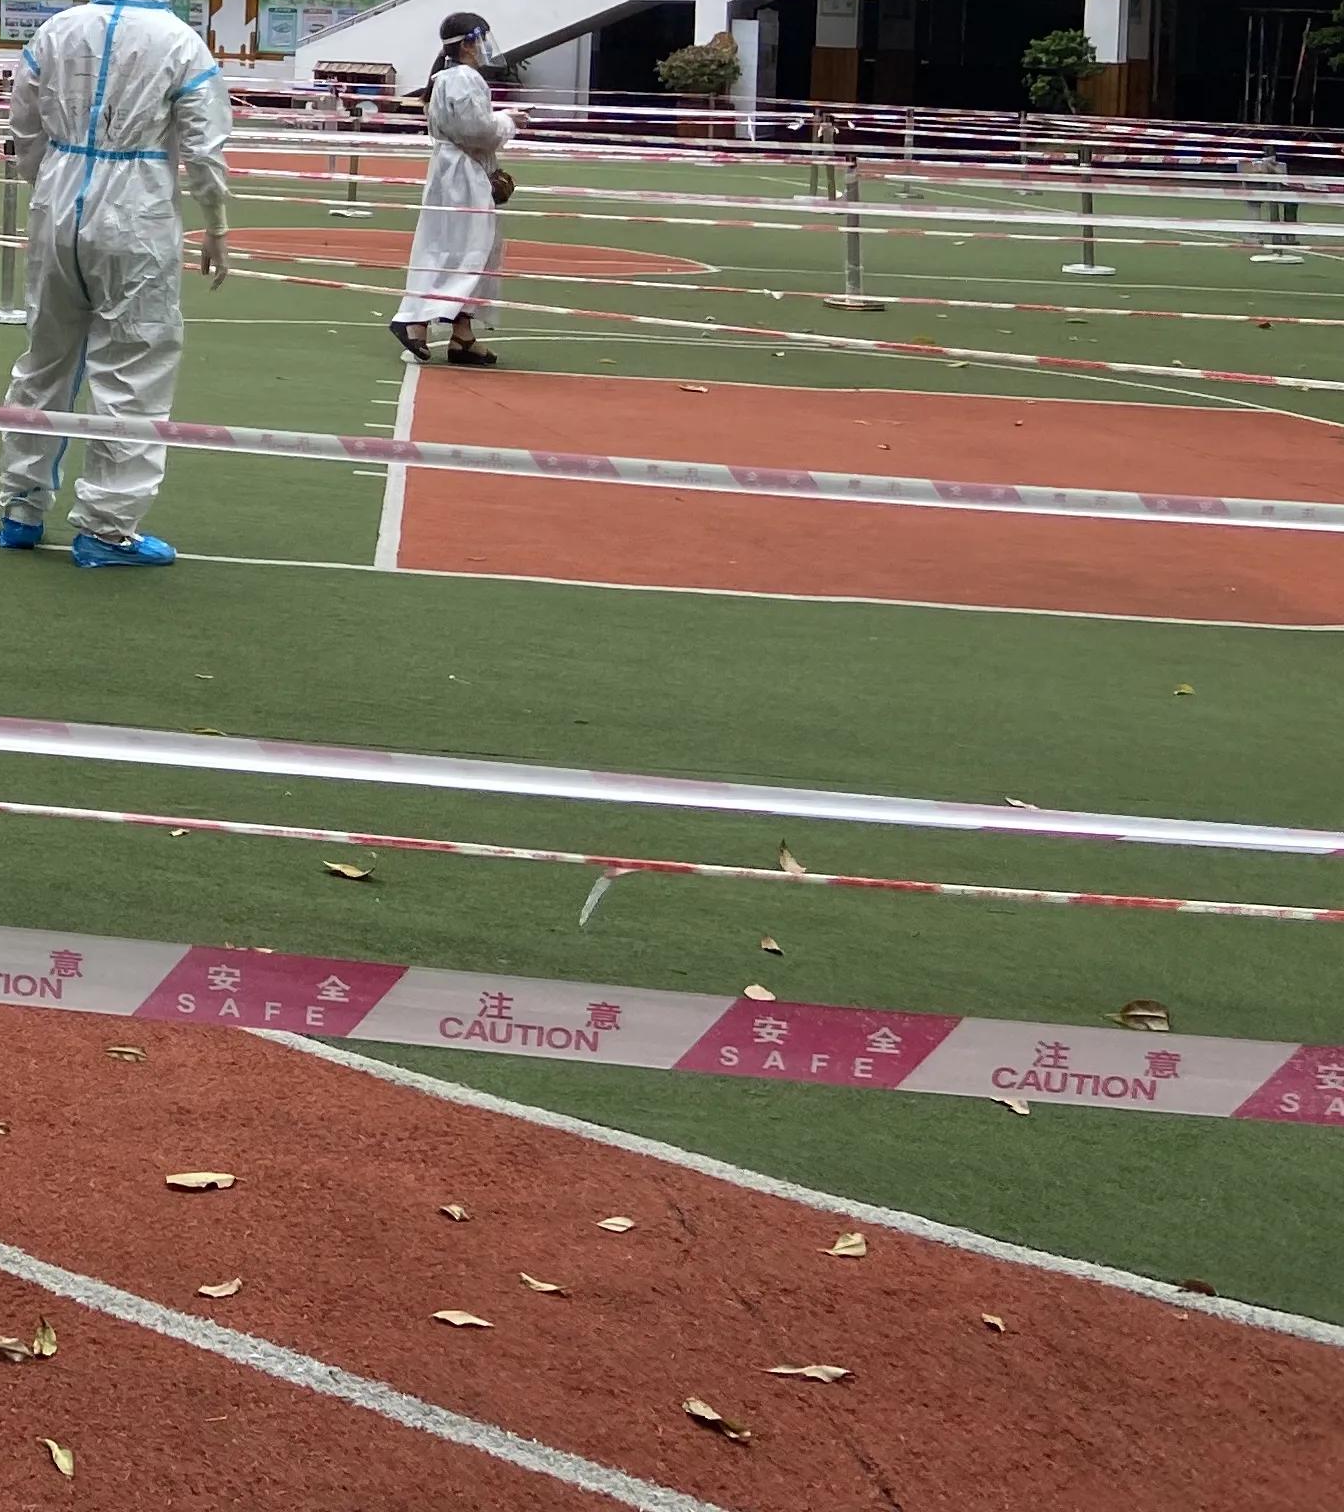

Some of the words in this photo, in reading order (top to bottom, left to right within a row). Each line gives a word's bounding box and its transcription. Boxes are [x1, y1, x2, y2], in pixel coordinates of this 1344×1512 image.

[208, 964, 350, 1003] 安全
[177, 993, 324, 1027] SAFE
[480, 992, 622, 1031] 注意
[439, 1017, 599, 1052] CAUTION
[752, 1016, 901, 1055] 安全
[719, 1046, 873, 1079] SAFE
[1034, 1041, 1181, 1079] 注意
[991, 1066, 1157, 1101] CAUTION
